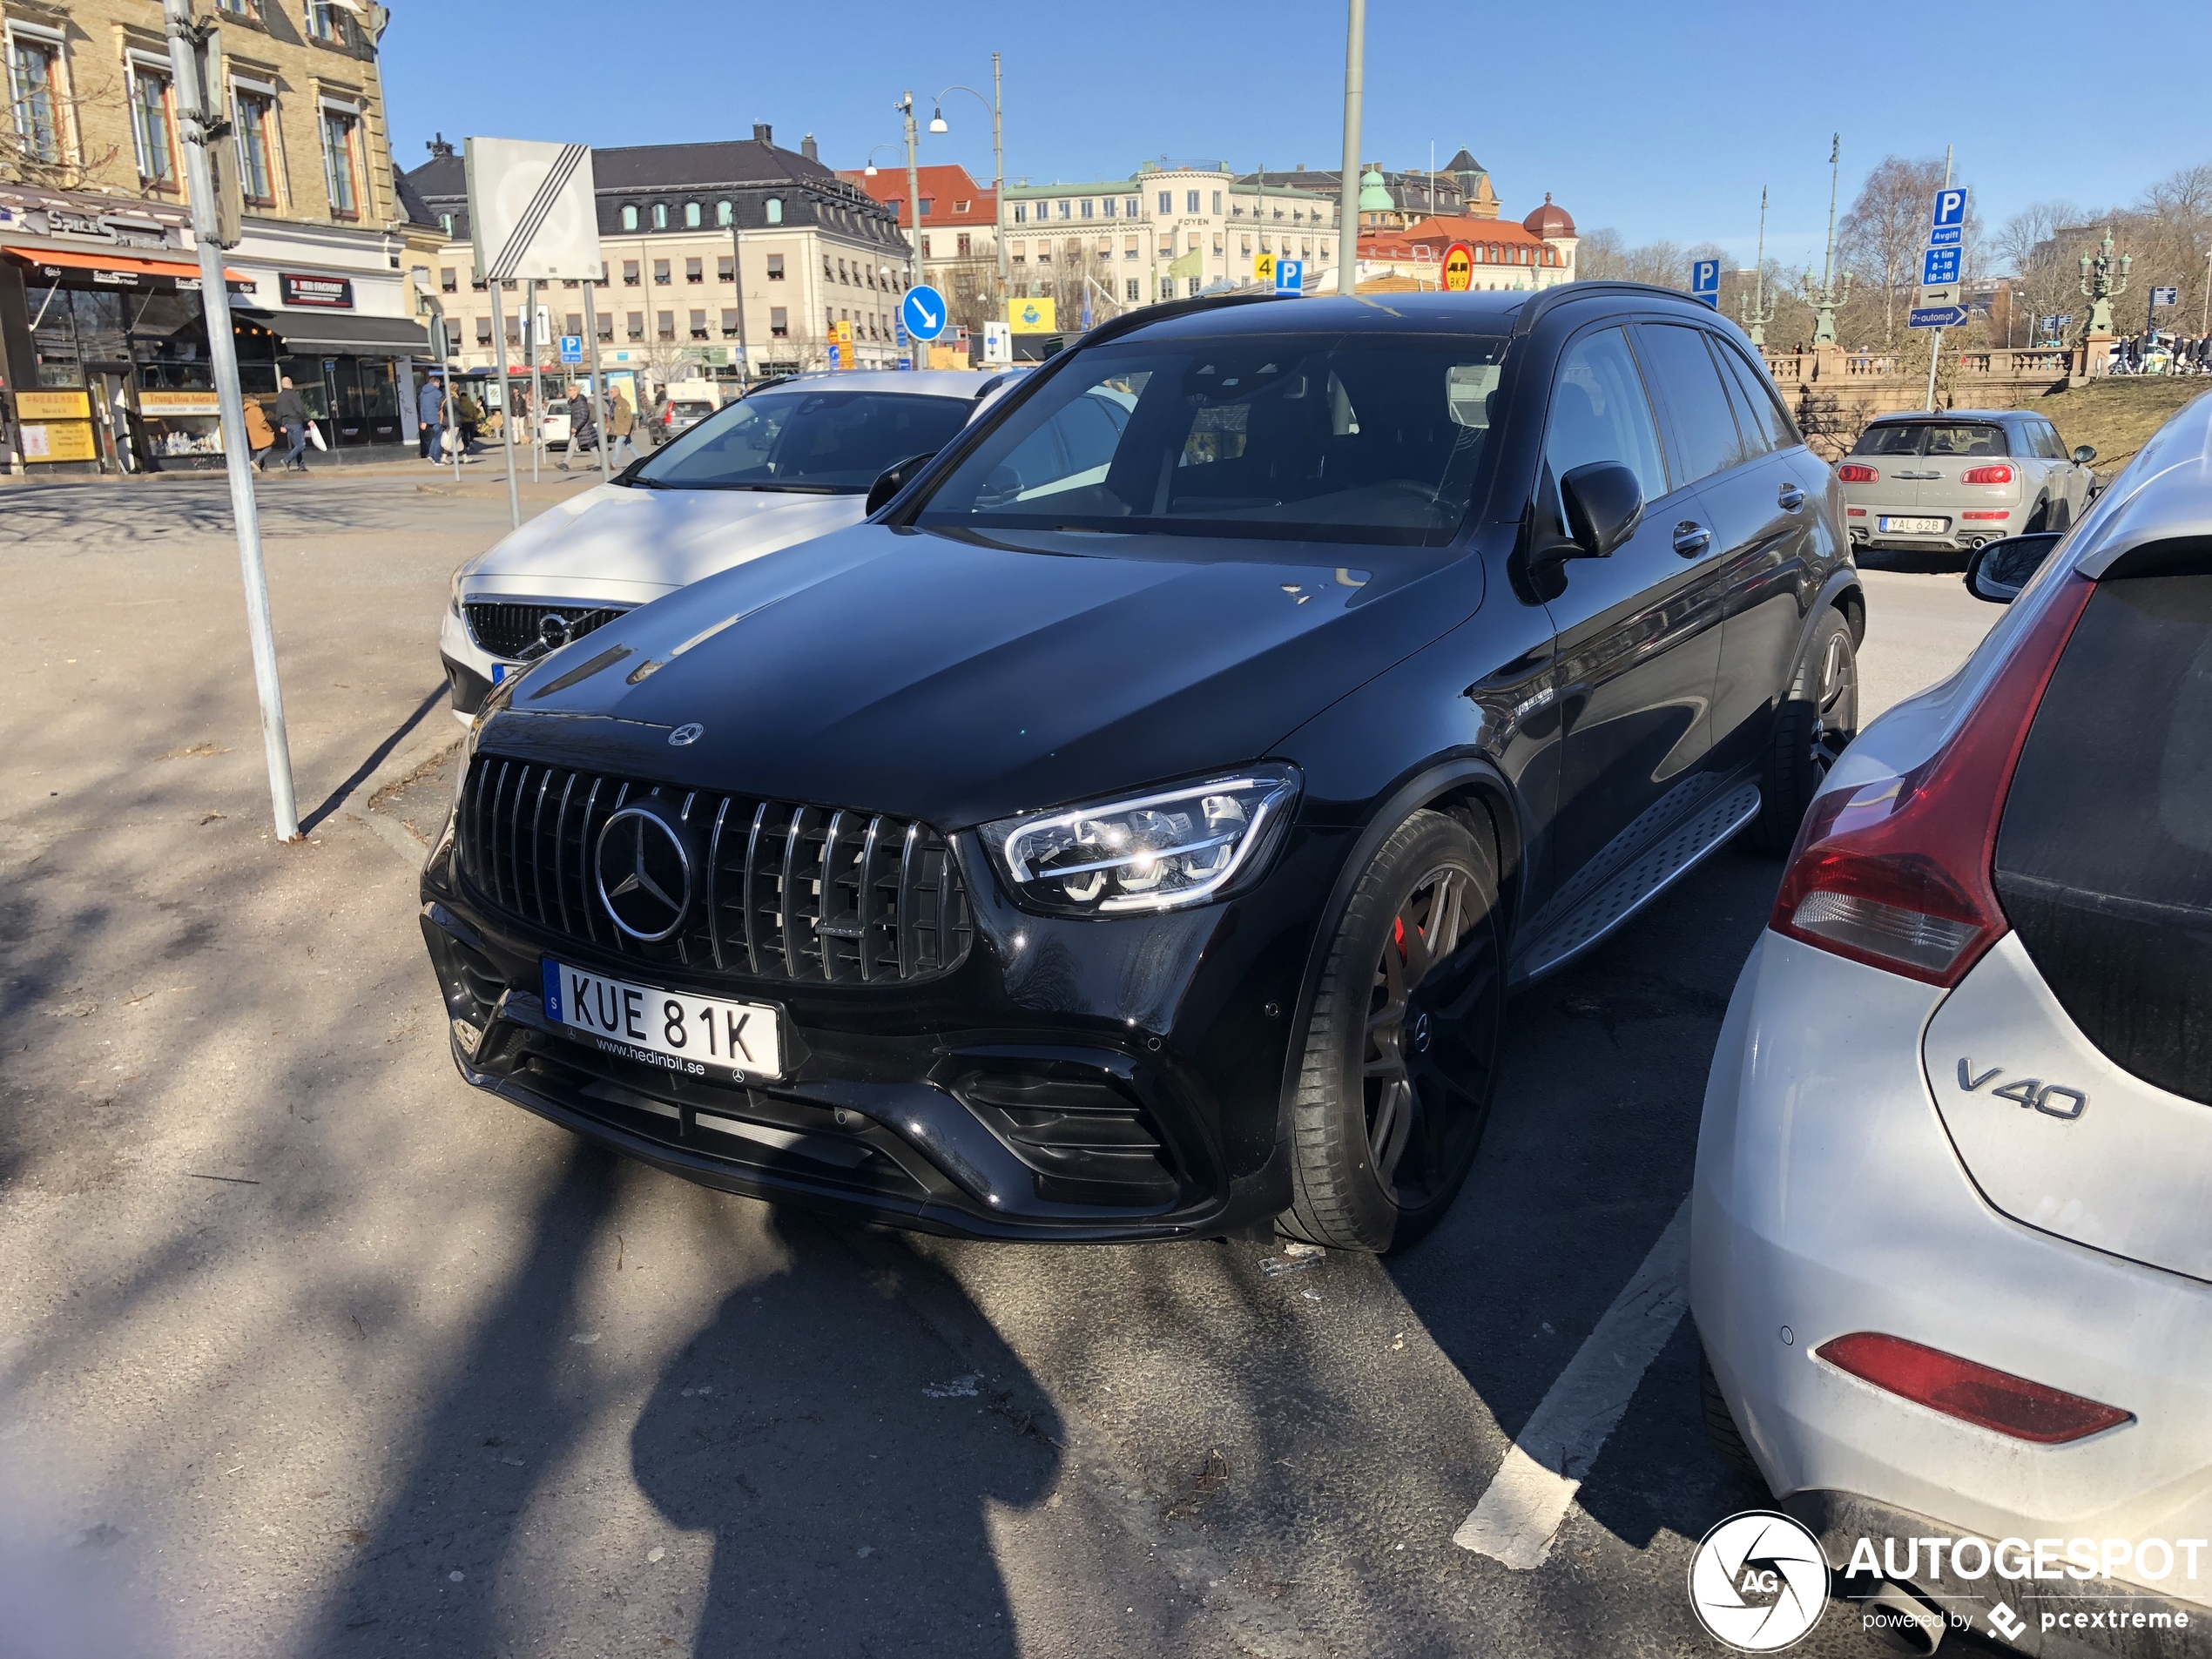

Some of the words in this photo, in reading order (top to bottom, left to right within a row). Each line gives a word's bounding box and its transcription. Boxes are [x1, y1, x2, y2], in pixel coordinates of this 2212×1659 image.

[1941, 192, 1961, 222] P
[1934, 231, 1959, 240] Avgift
[1932, 251, 1939, 260] 4
[1941, 250, 1954, 259] tim
[1258, 258, 1271, 275] 4
[1932, 261, 1952, 271] 8-18
[1283, 262, 1298, 287] P
[1699, 263, 1714, 290] P
[1911, 312, 1954, 323] P-automat
[566, 338, 577, 352] P
[1891, 519, 1912, 529] YAL
[1916, 520, 1939, 530] 62B
[550, 996, 557, 1010] S
[571, 973, 648, 1042] KUE
[663, 999, 756, 1063] 81K
[597, 1038, 705, 1076] www.hedinbil.se
